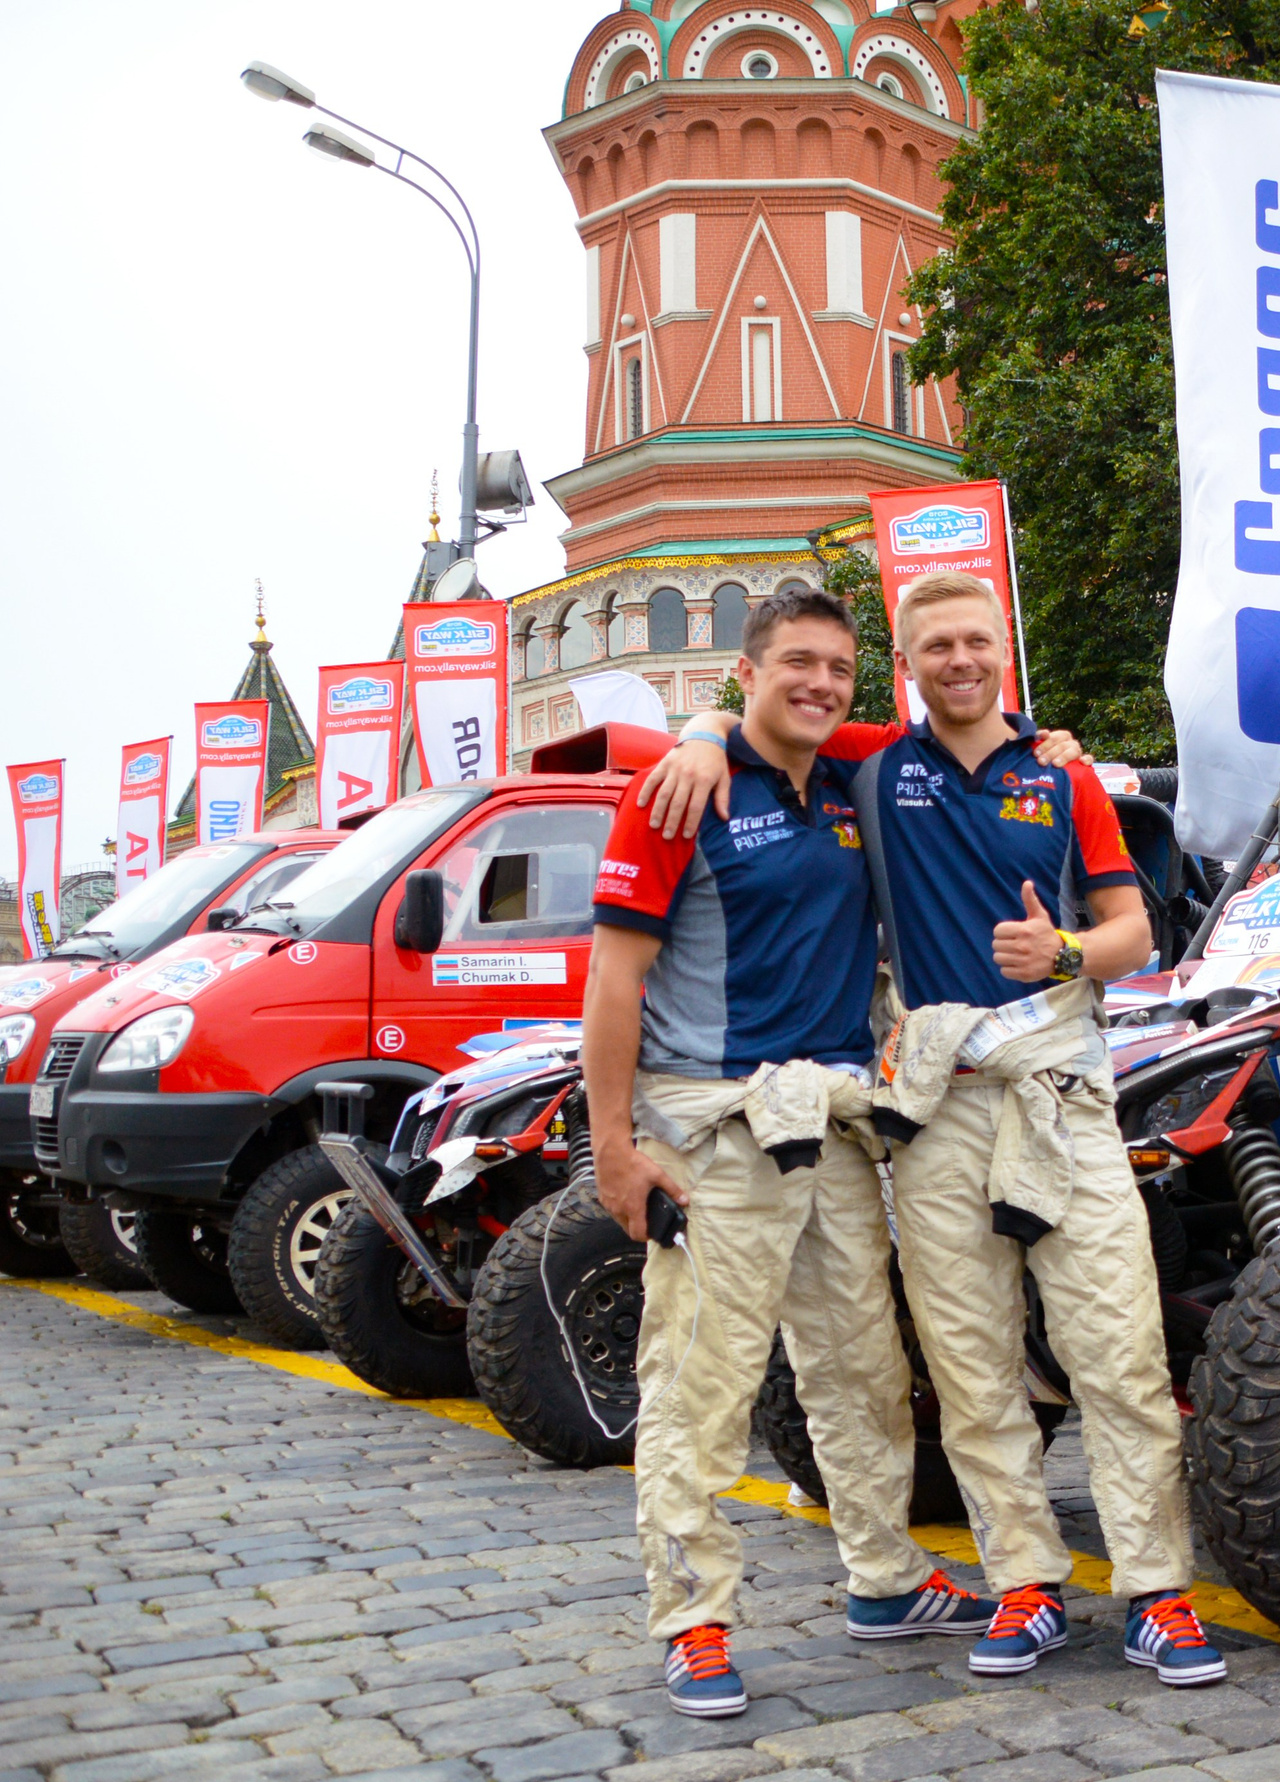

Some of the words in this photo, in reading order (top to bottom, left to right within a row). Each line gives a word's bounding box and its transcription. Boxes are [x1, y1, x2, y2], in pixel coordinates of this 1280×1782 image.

[896, 782, 926, 796] PRIDE
[733, 832, 769, 852] PRIDE
[1228, 900, 1276, 921] SILK
[1248, 933, 1270, 949] 116
[461, 956, 515, 967] Samarin
[461, 972, 516, 983] Chumak
[520, 972, 534, 982] D.
